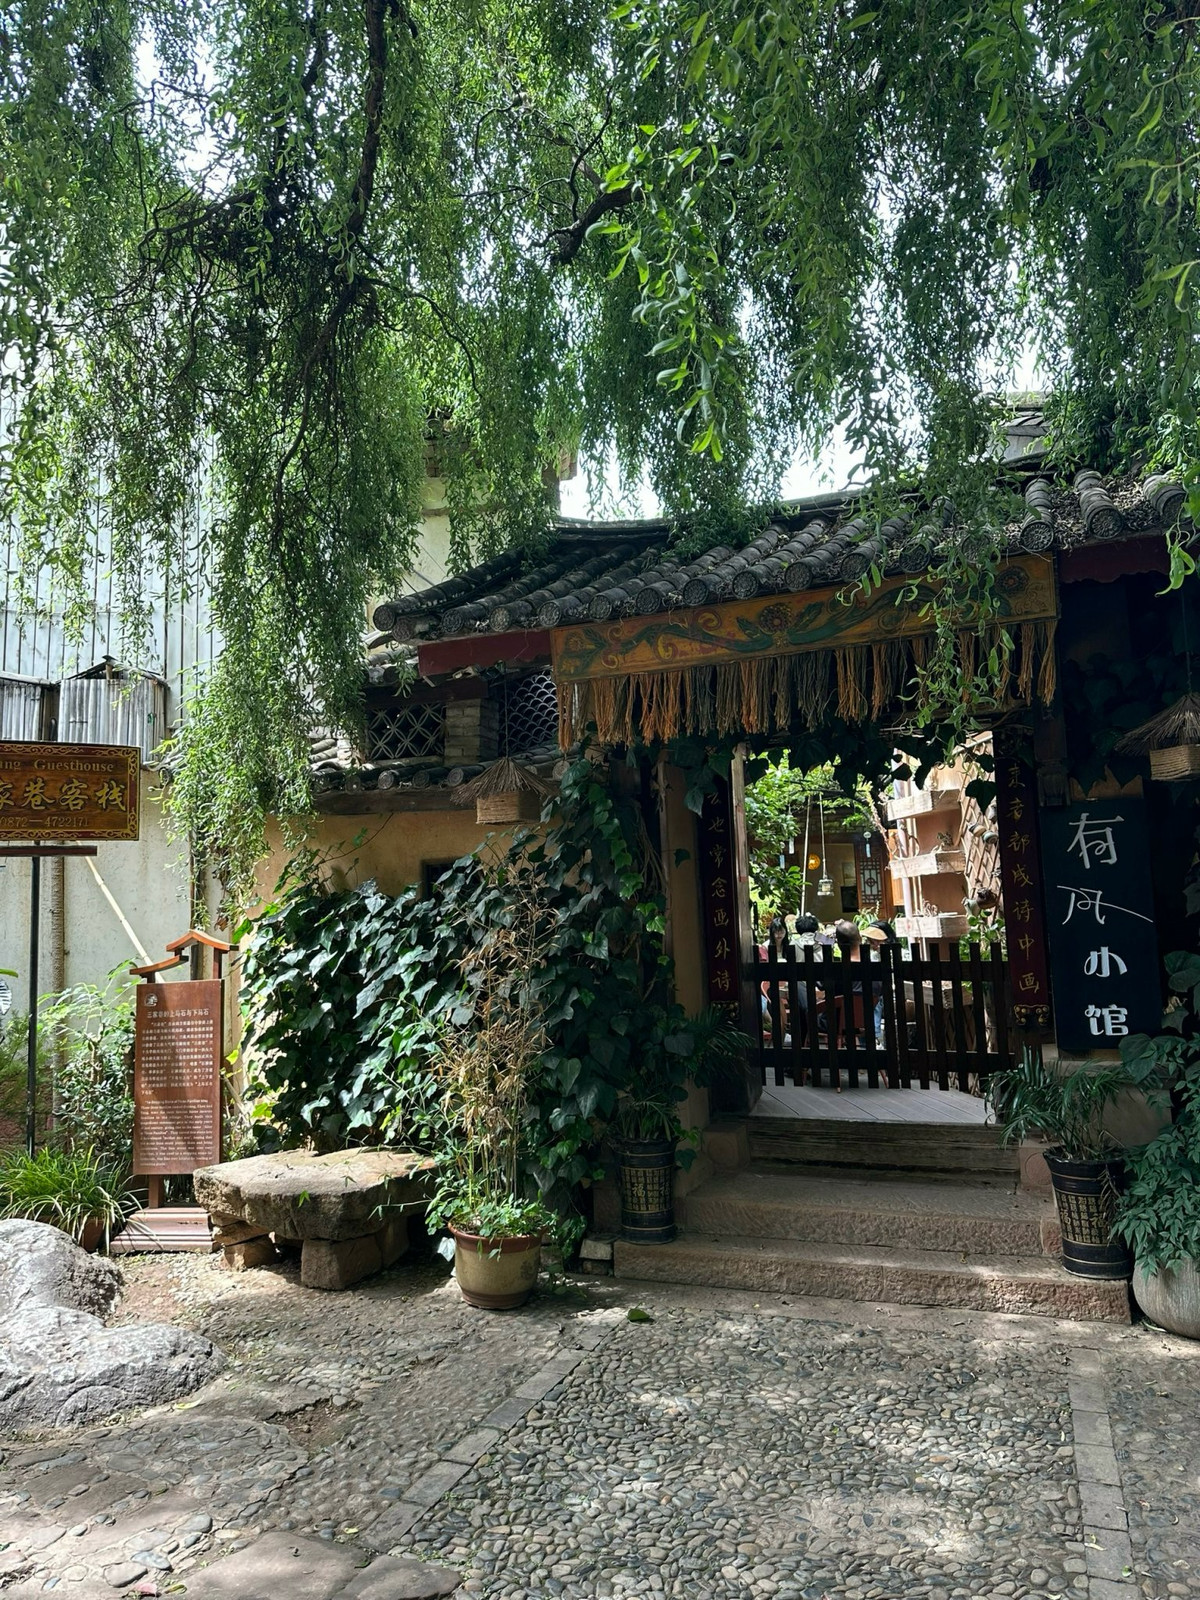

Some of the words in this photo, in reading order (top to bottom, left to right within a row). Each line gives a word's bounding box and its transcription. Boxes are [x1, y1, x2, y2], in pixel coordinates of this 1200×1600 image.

[34, 759, 114, 772] Guesthouse
[1057, 813, 1154, 1036] 有风小馆
